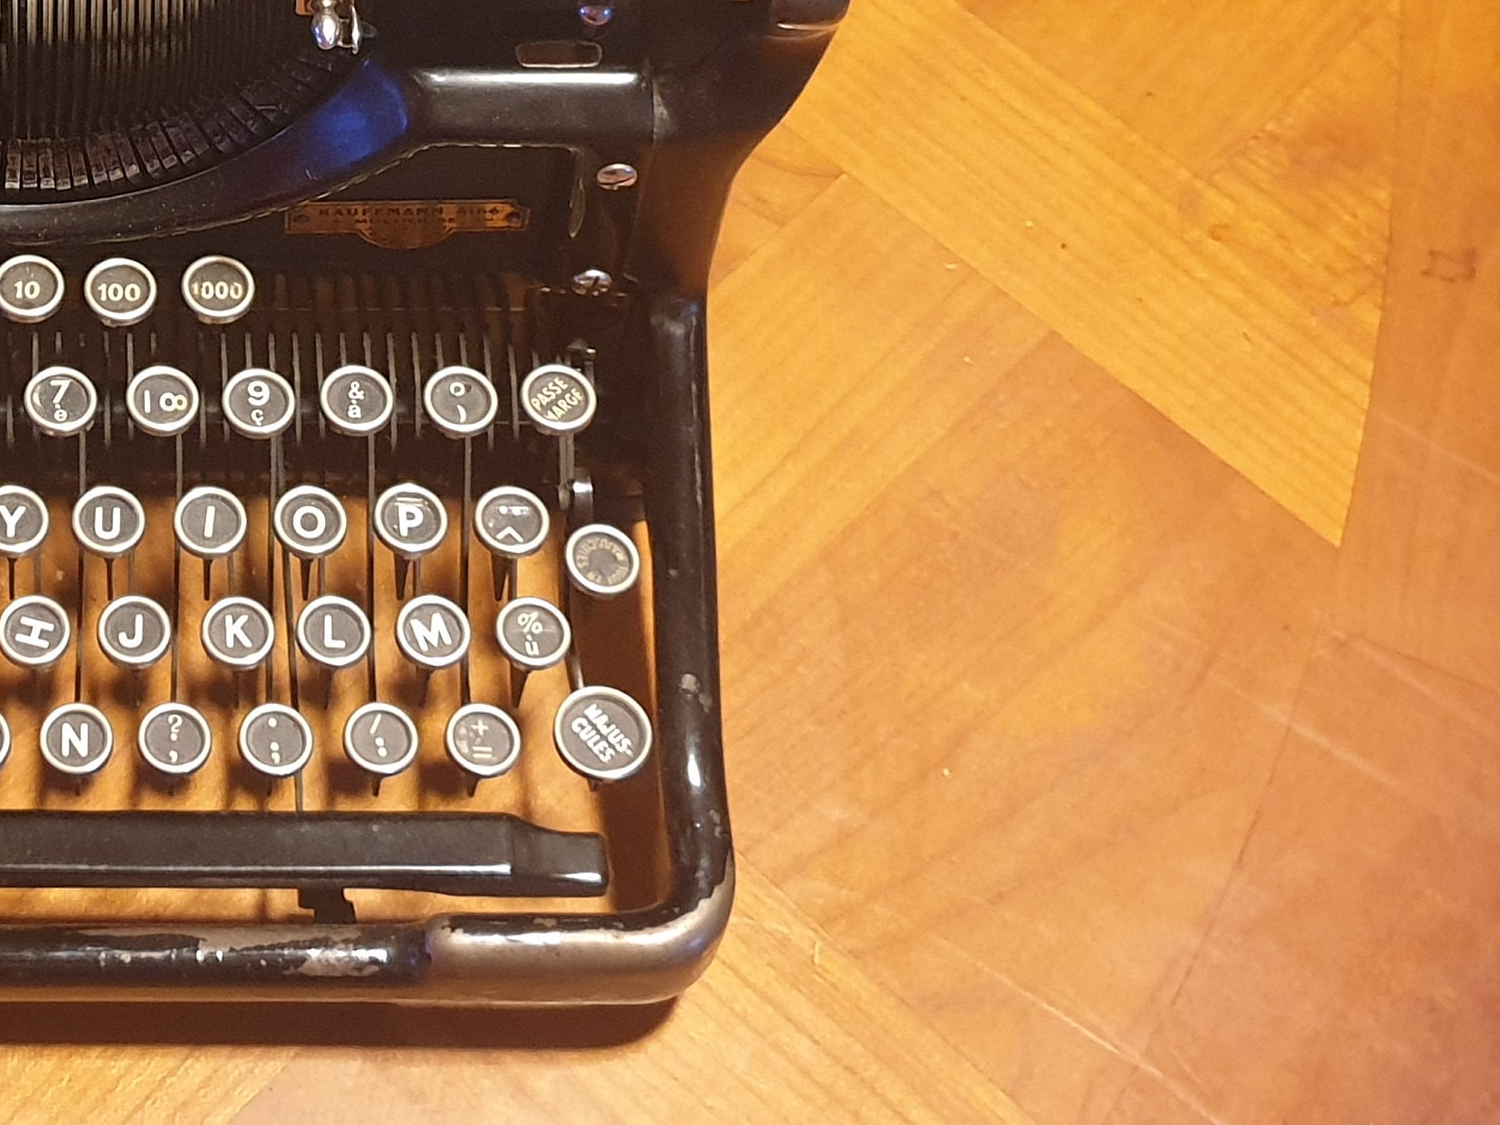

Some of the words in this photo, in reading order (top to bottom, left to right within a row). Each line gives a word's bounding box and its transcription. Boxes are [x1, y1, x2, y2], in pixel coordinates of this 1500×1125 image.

[14, 280, 41, 300] 10
[97, 282, 141, 302] 100
[189, 281, 247, 304] 1000
[49, 378, 73, 404] 7
[247, 380, 271, 407] 9
[531, 377, 569, 411] PASSE
[94, 506, 121, 540] U
[203, 505, 216, 538] I
[292, 505, 326, 539] O
[396, 503, 424, 537] P
[14, 615, 55, 650] H
[118, 614, 144, 649] J
[224, 614, 253, 649] K
[323, 614, 347, 649] L
[409, 612, 452, 652] M
[61, 722, 89, 758] N
[167, 714, 183, 742] ?
[571, 717, 615, 763] CULES
